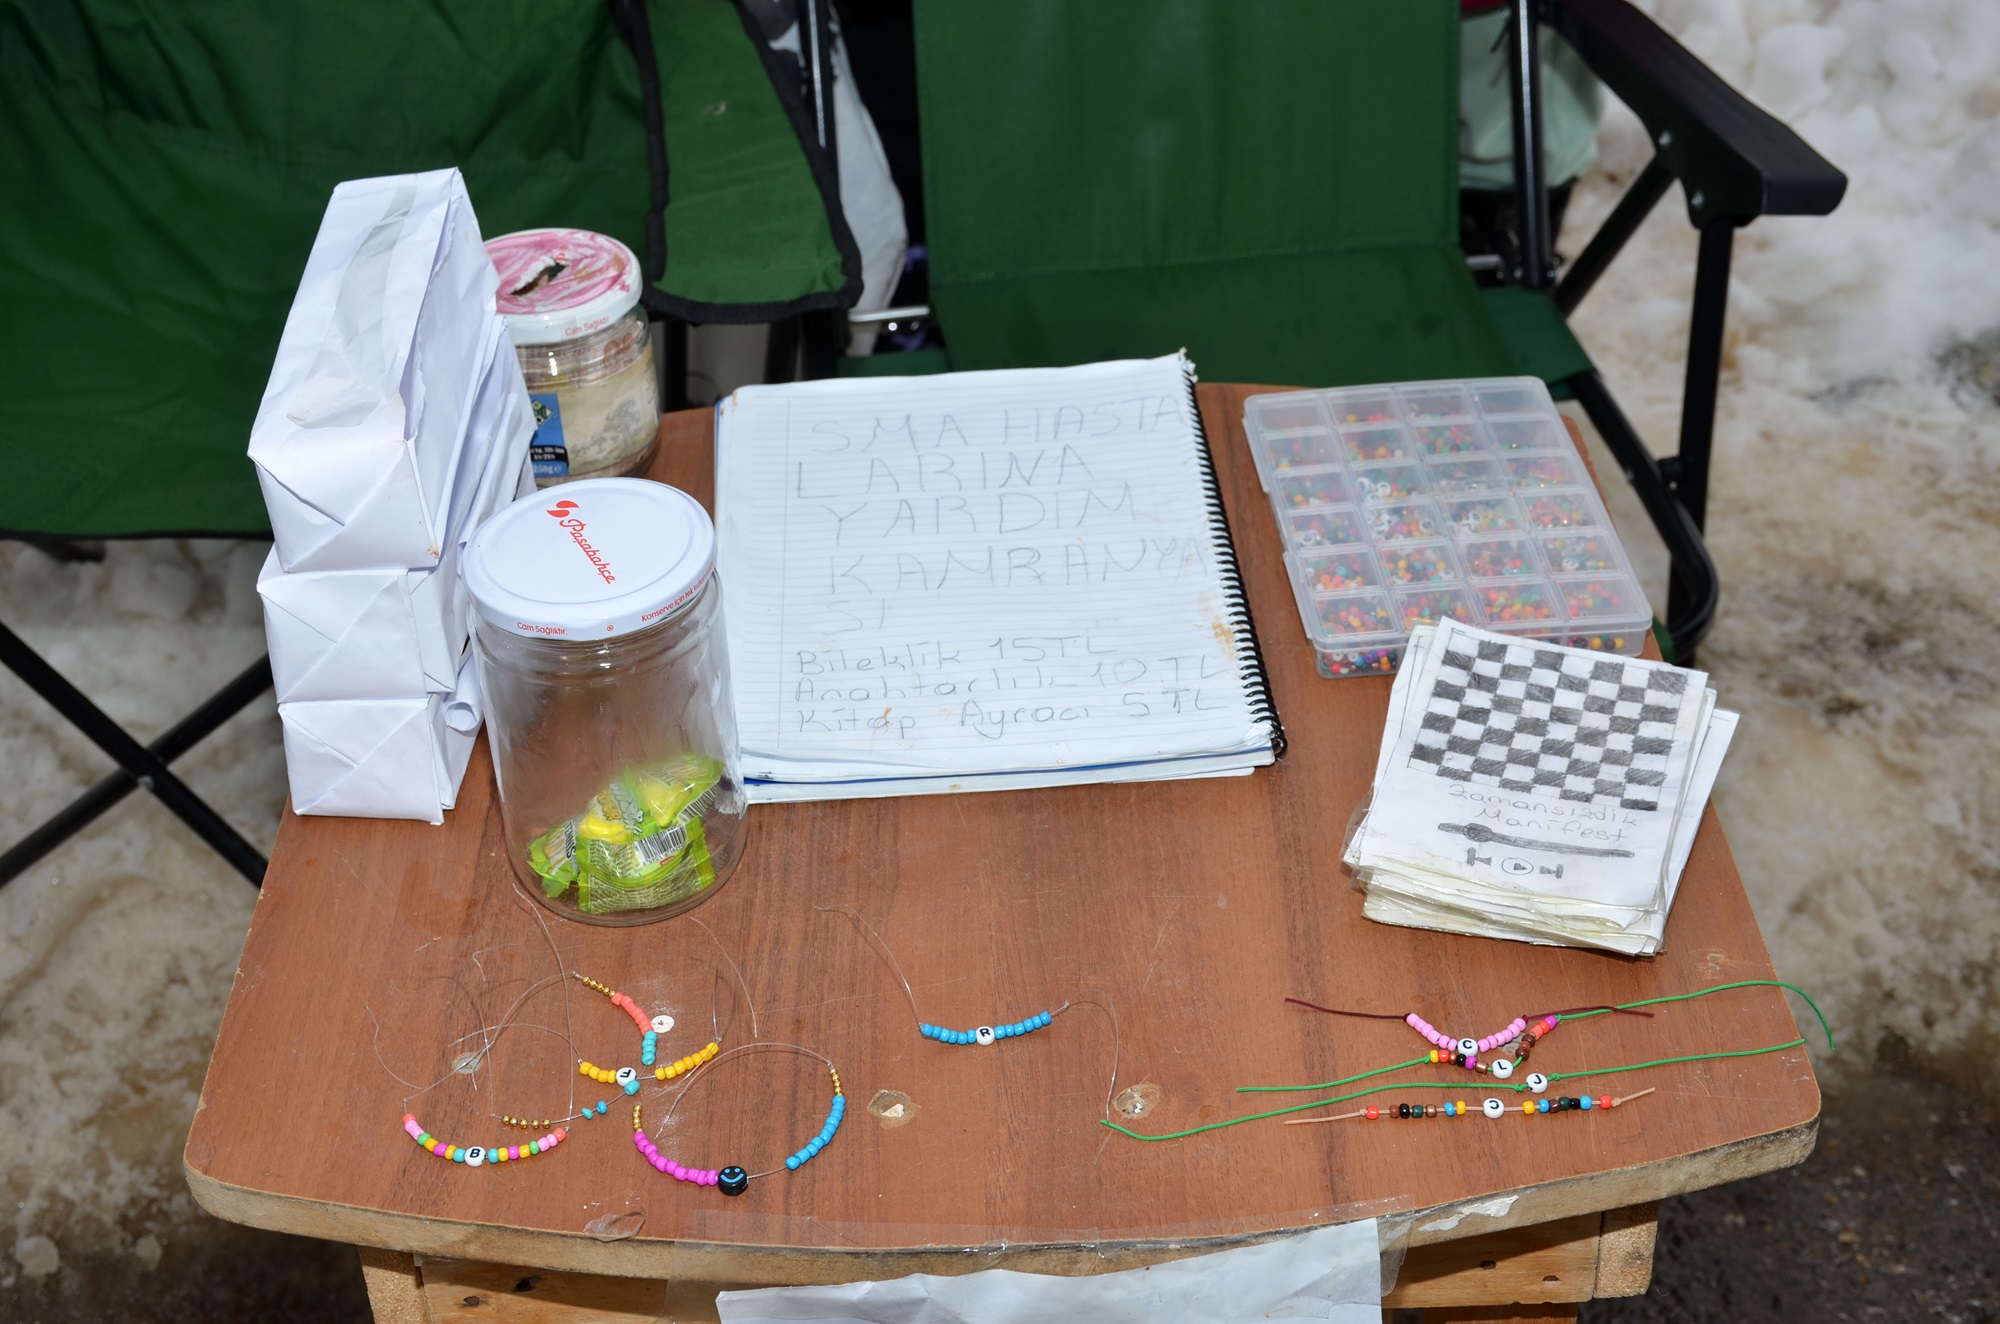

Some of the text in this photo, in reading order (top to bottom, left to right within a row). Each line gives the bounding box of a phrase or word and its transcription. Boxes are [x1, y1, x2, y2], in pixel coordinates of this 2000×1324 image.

[811, 395, 1187, 453] SMA HASTA
[796, 444, 1095, 499] LARINA
[820, 482, 1137, 546] YARDIM
[559, 518, 616, 584] Paşabahçe
[516, 621, 534, 632] Cam
[641, 602, 674, 622] Konserve
[796, 640, 961, 675] Bileklik
[798, 707, 916, 739] Kitap
[979, 1027, 991, 1037] R
[1462, 1039, 1473, 1049] C
[469, 1148, 481, 1158] B
